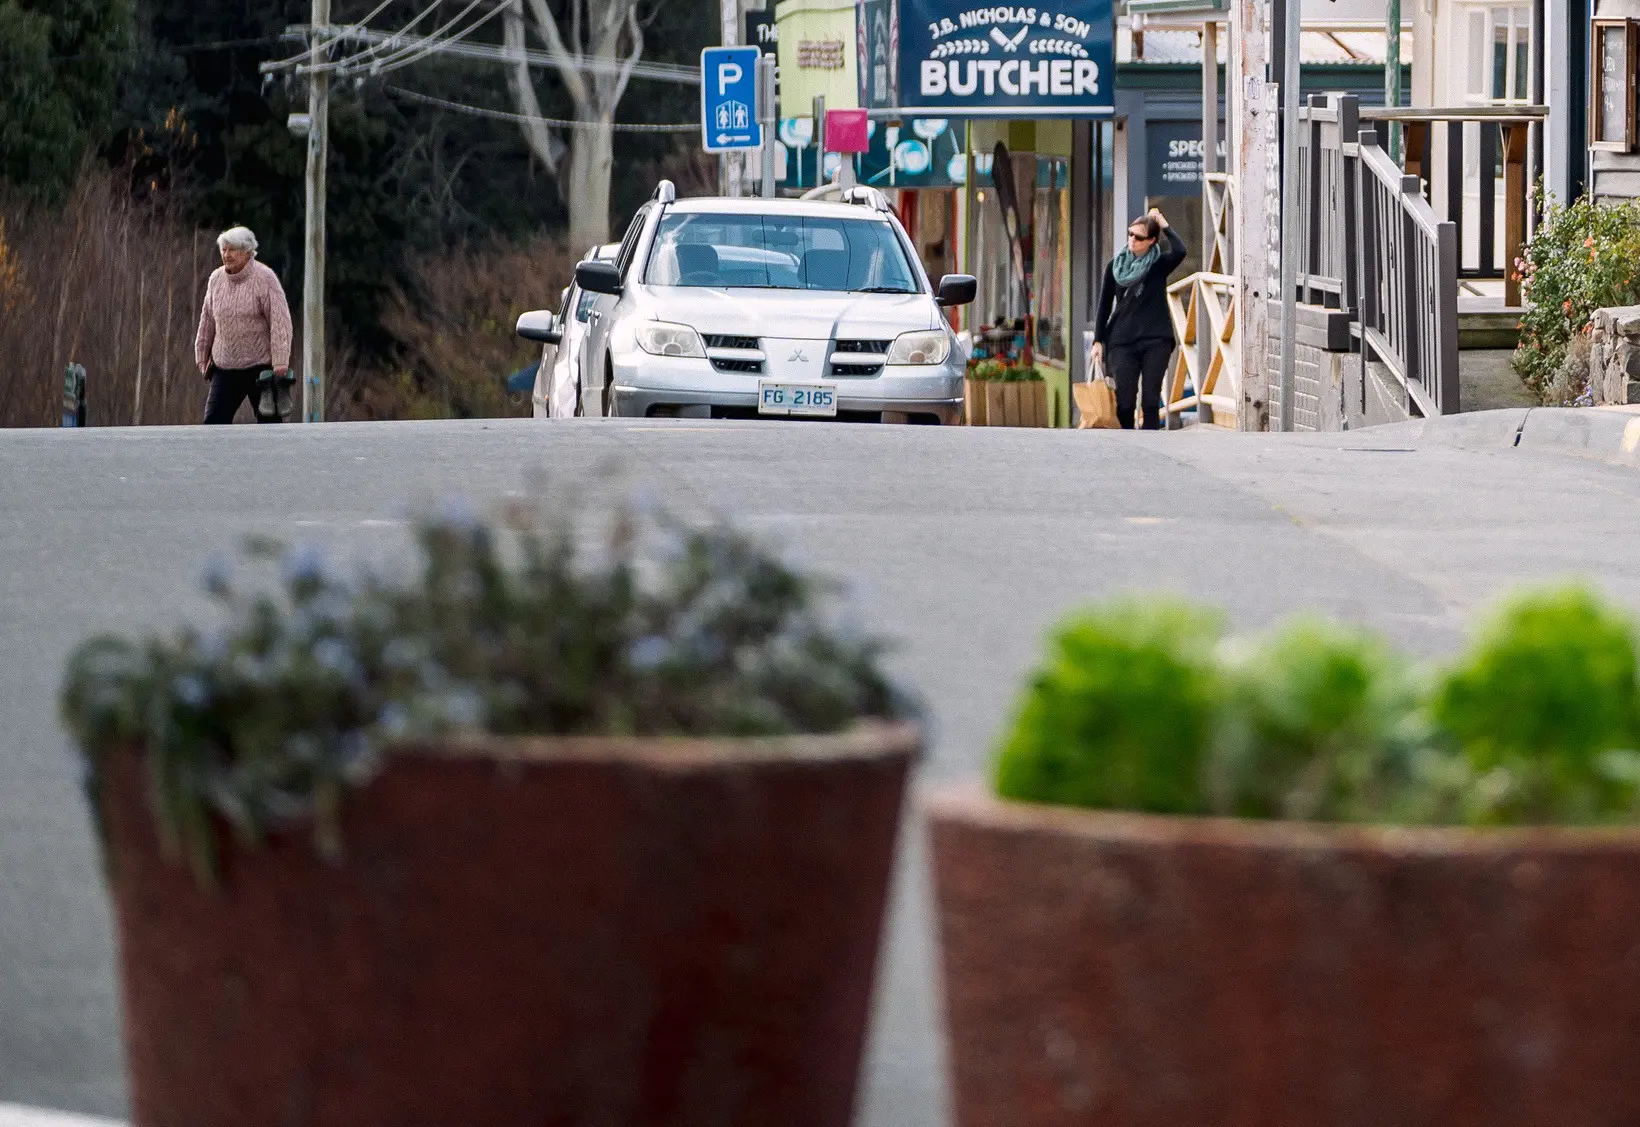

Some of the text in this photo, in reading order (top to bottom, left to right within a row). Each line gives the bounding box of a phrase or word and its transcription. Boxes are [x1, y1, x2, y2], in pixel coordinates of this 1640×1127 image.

[928, 6, 1091, 40] J.B. NICHOLAS & SON
[718, 62, 743, 97] P
[920, 59, 1099, 97] BUTCHER
[764, 389, 832, 406] FG 2185
